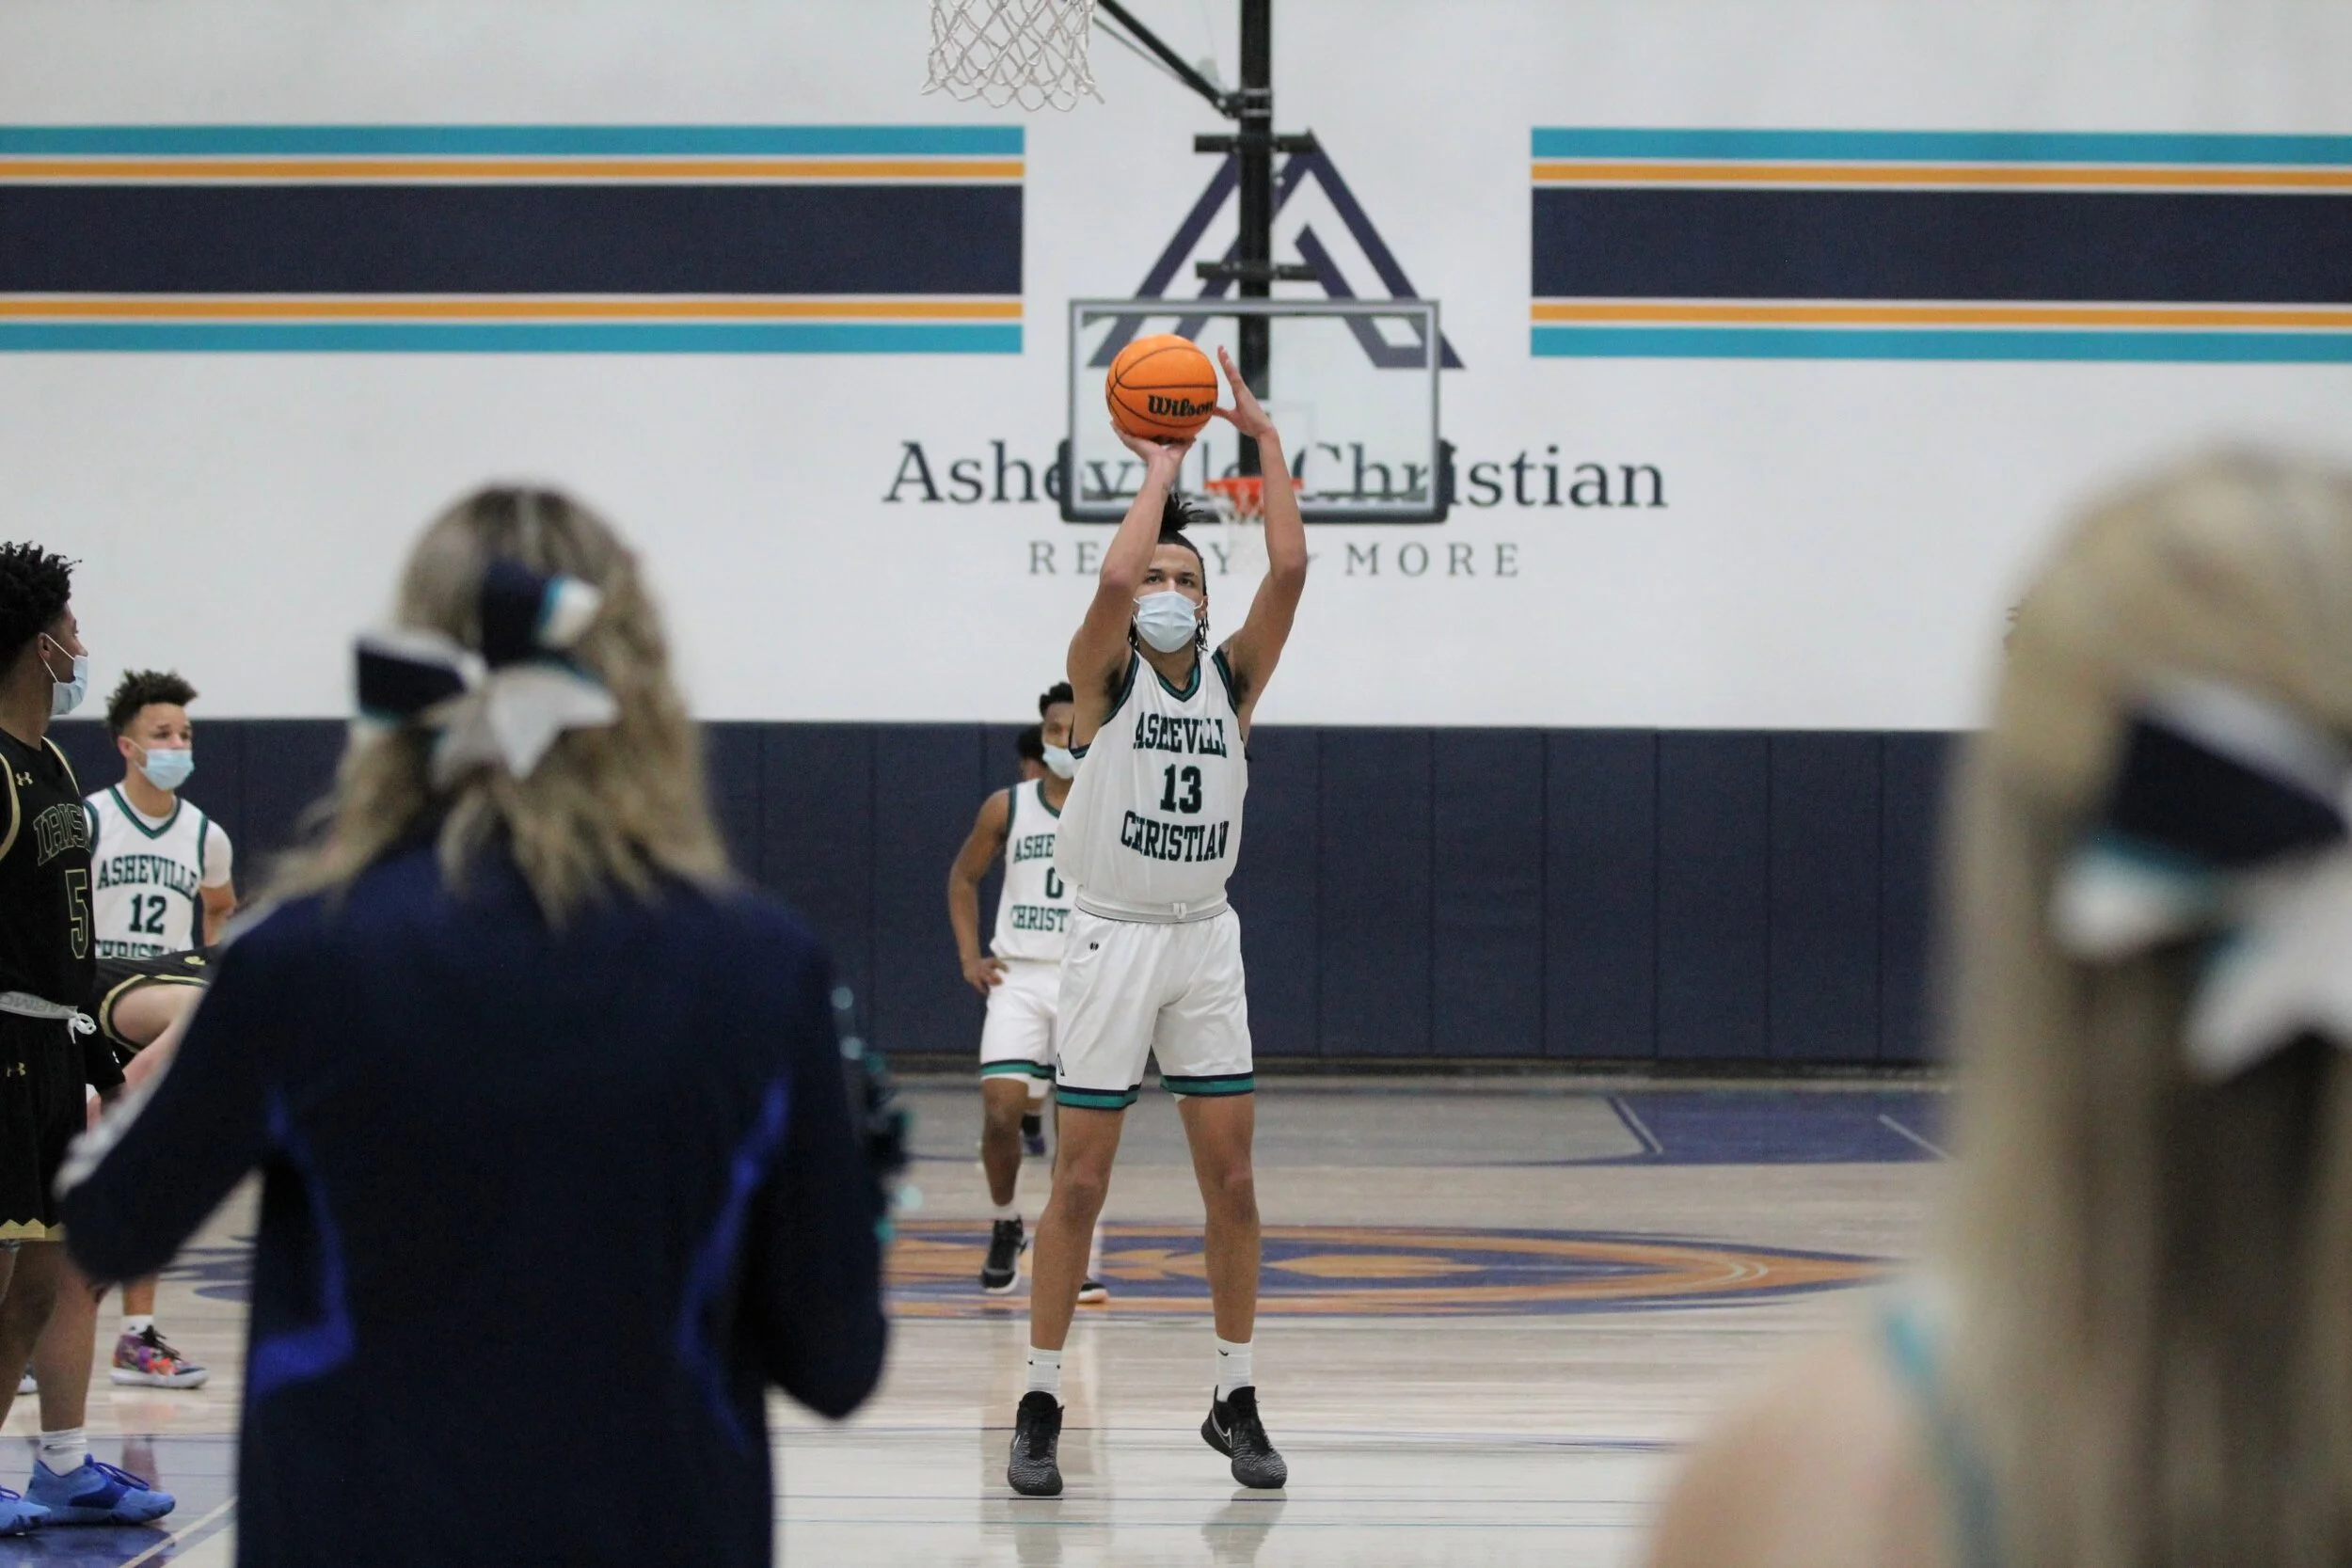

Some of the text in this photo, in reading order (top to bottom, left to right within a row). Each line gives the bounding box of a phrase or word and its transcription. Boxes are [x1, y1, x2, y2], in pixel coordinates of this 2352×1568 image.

[1148, 395, 1214, 417] Wilson
[1028, 541, 1234, 576] REY
[1345, 543, 1520, 578] MORE
[1160, 764, 1202, 814] 13
[65, 868, 89, 959] 5
[129, 894, 167, 935] 12
